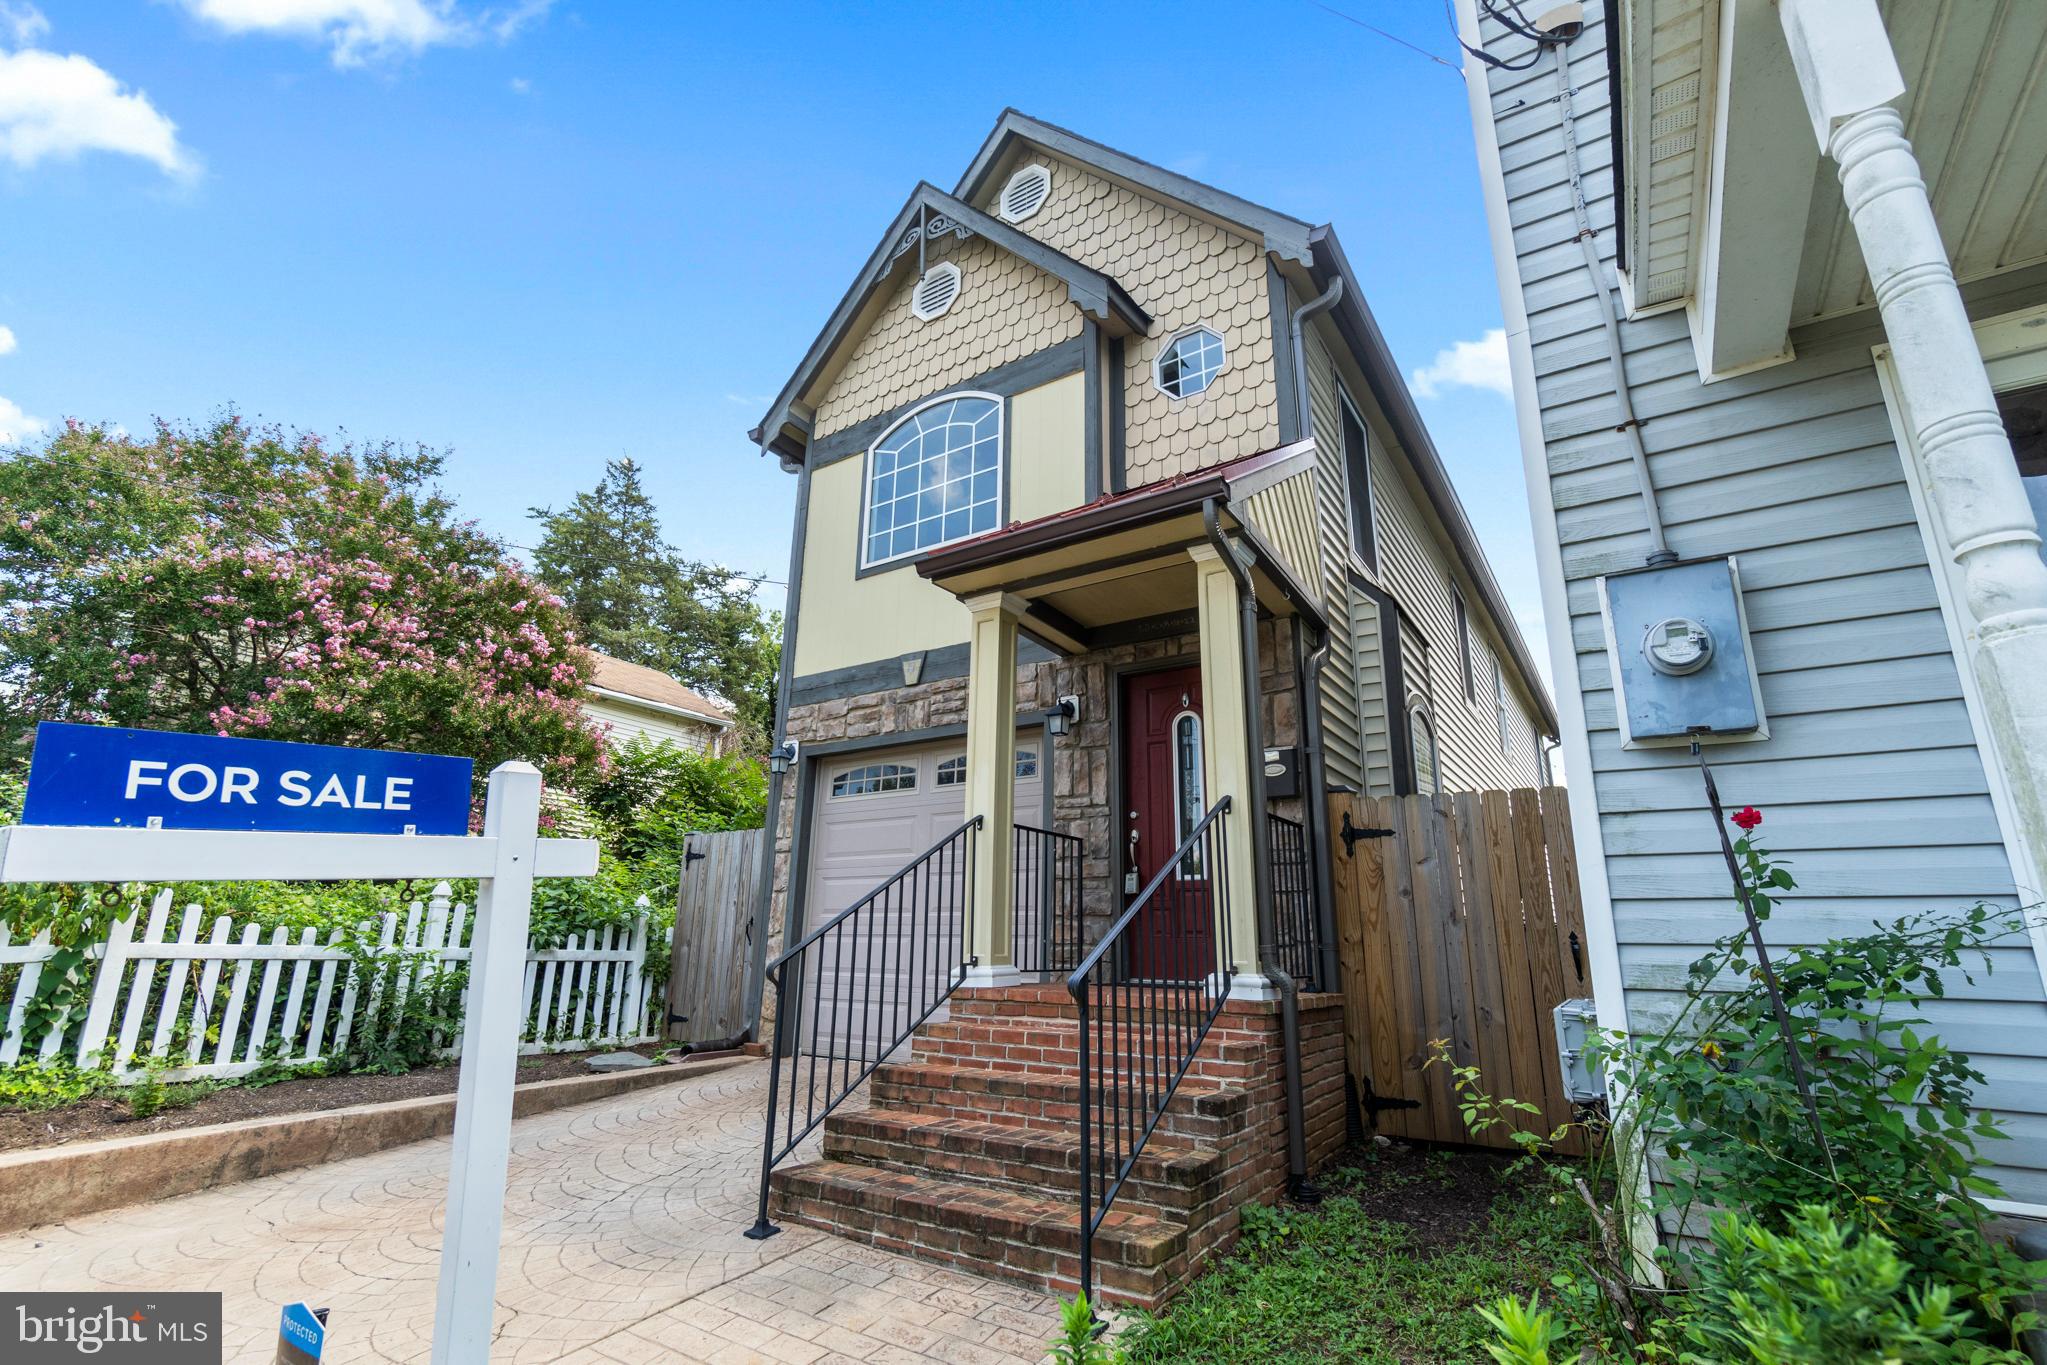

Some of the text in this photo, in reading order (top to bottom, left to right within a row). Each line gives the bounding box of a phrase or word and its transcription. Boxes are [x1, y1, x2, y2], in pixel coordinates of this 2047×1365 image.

[125, 760, 414, 811] FOR SALE
[282, 1314, 318, 1345] PROTECTED
